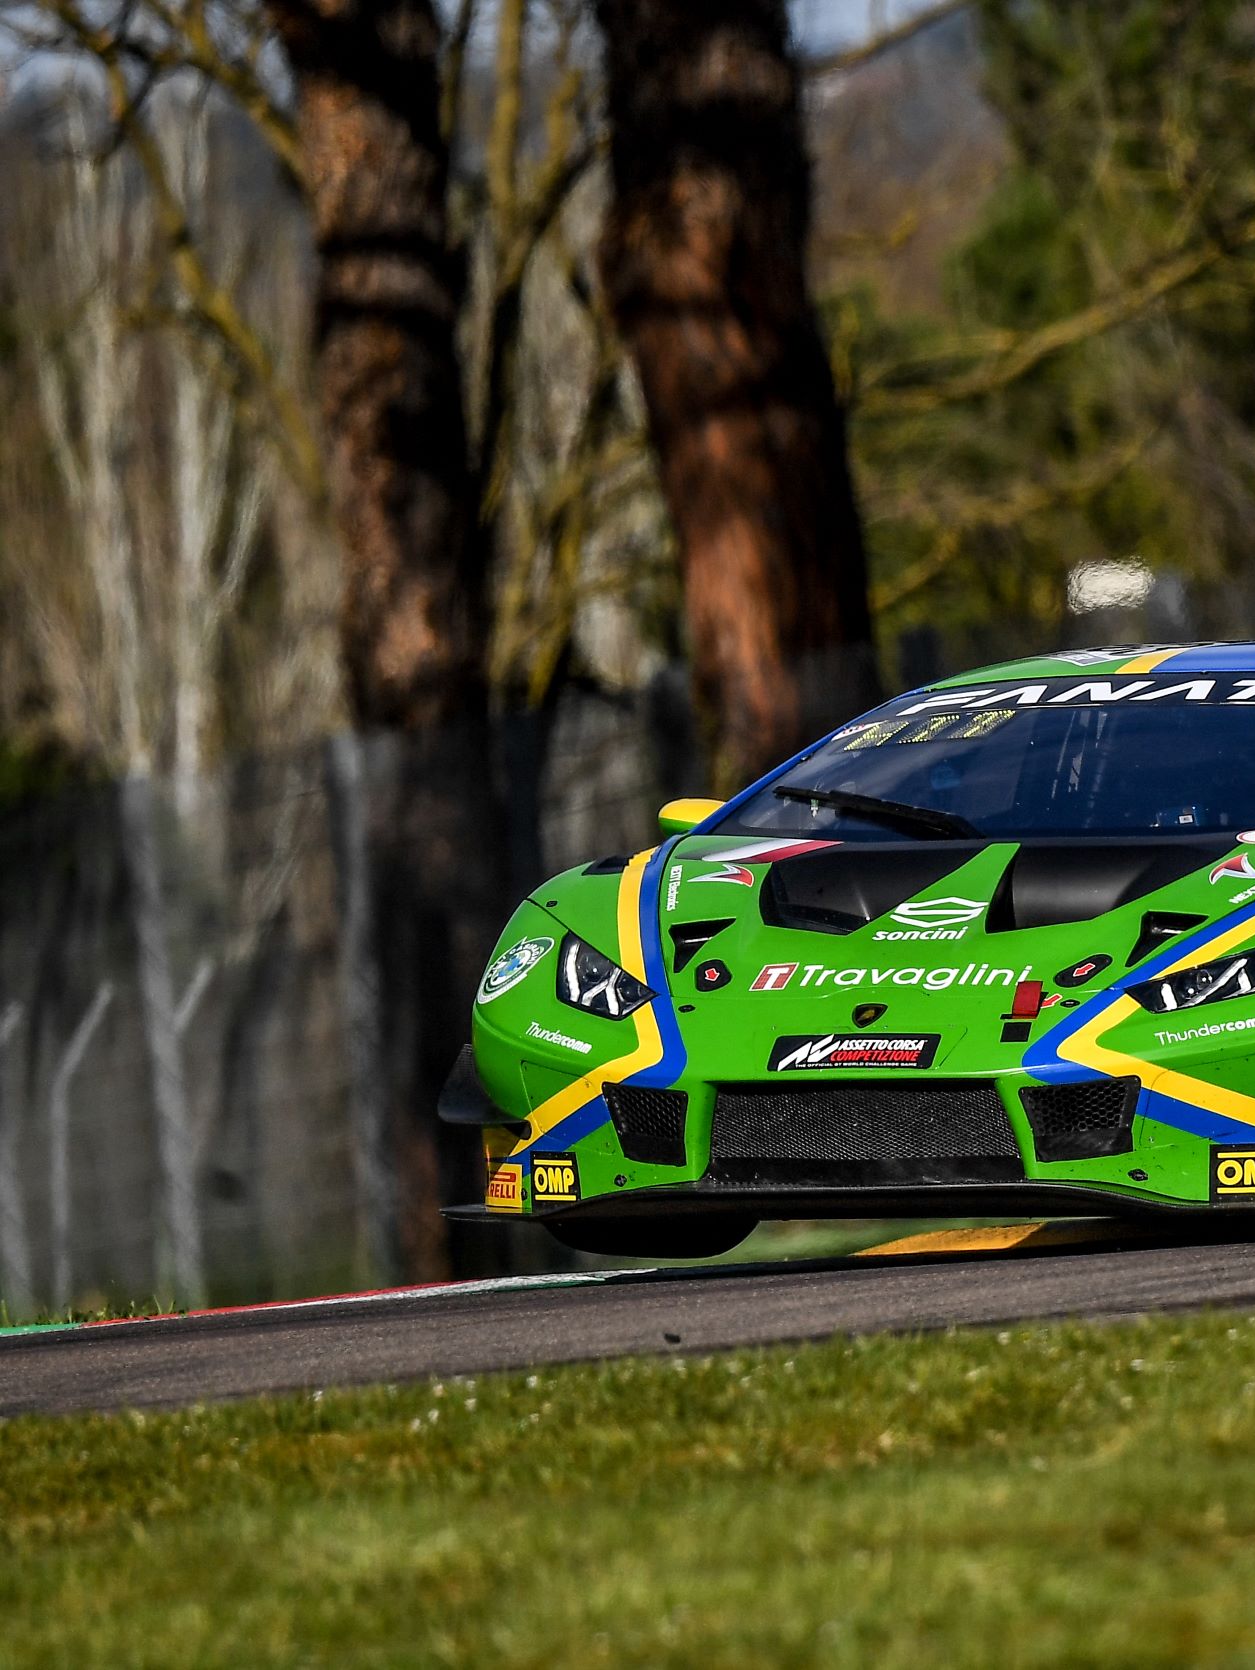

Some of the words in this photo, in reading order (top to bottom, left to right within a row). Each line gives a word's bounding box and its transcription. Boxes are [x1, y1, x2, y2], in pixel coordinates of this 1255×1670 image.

[872, 926, 969, 941] soncini
[800, 963, 1033, 991] Travaglini
[526, 1021, 593, 1054] Thundercomm
[839, 1039, 888, 1051] ASSETTO
[888, 1039, 924, 1051] CORSA
[830, 1050, 921, 1062] COMPETIZIONE
[490, 1171, 517, 1199] RELLI
[534, 1166, 575, 1194] OMP
